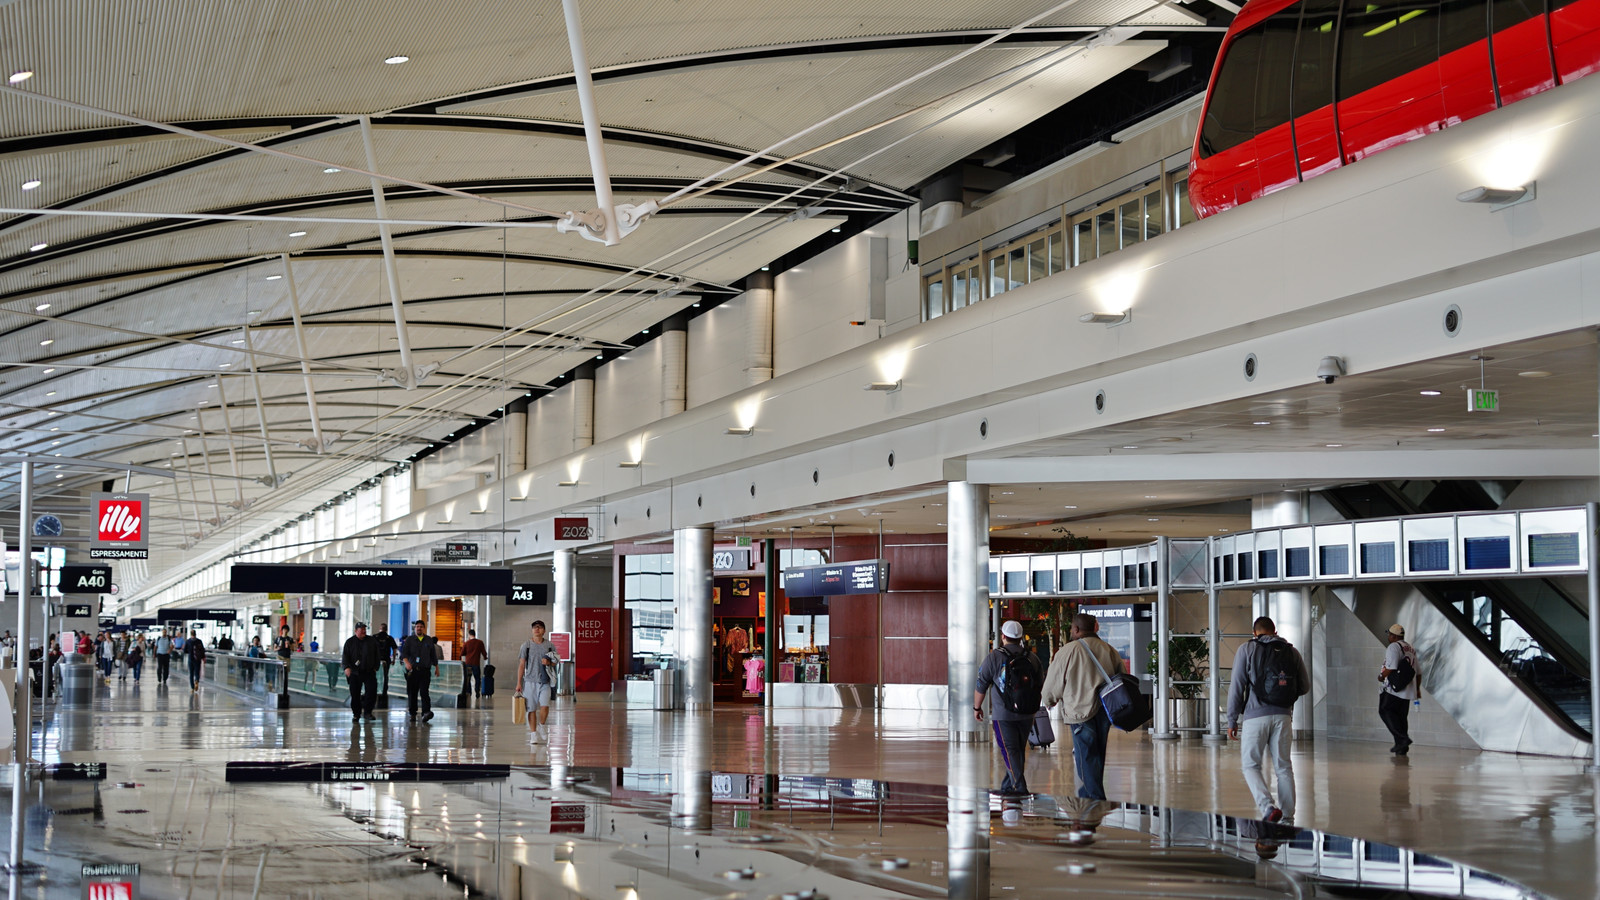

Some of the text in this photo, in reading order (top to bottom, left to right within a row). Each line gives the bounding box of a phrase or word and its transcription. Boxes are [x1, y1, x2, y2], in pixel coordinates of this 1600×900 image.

[1476, 391, 1495, 408] EXIT
[99, 504, 140, 539] illy
[562, 526, 594, 538] ZOZO
[739, 536, 751, 546] EXIT
[91, 550, 147, 558] ESPRESSAMENTE
[77, 575, 105, 588] A40
[512, 590, 533, 600] A43
[1104, 609, 1126, 618] DIRECTORY
[578, 620, 601, 629] NEED
[577, 629, 605, 638] HELP?
